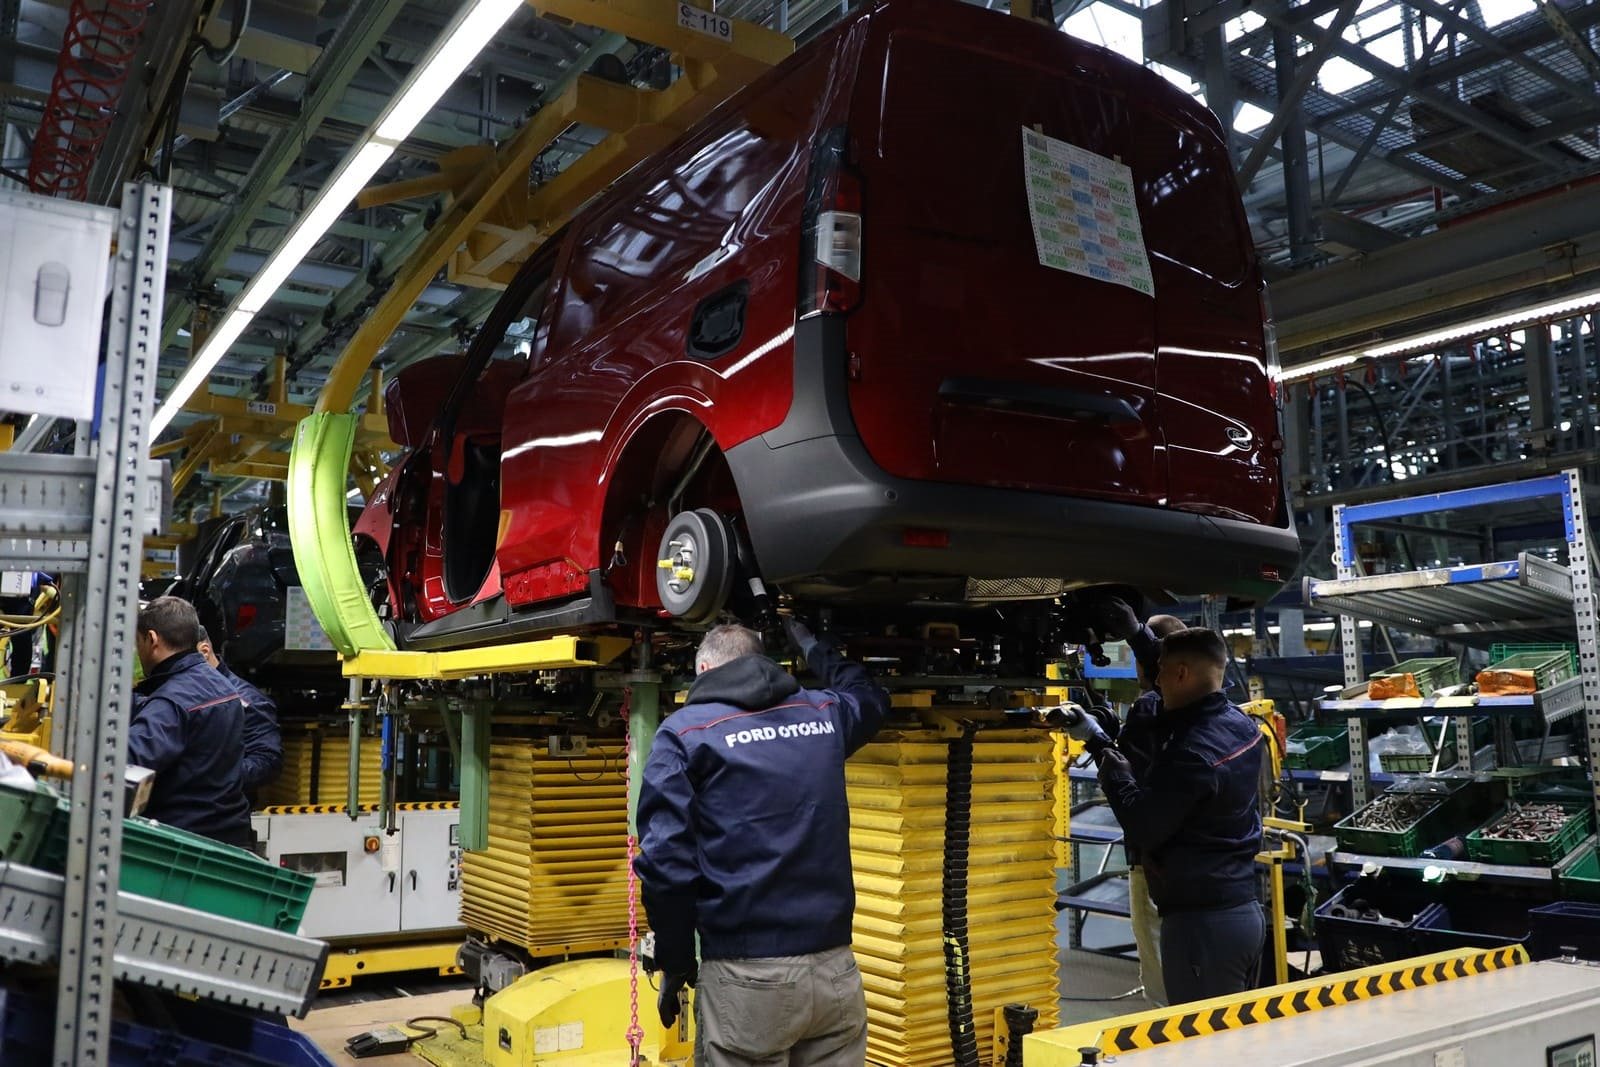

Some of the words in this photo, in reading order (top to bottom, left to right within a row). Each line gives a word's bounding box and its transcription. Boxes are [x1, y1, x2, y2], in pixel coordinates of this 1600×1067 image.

[700, 14, 730, 37] 119
[259, 404, 274, 413] 118
[725, 726, 777, 748] FORD
[778, 721, 835, 738] OTOSAN
